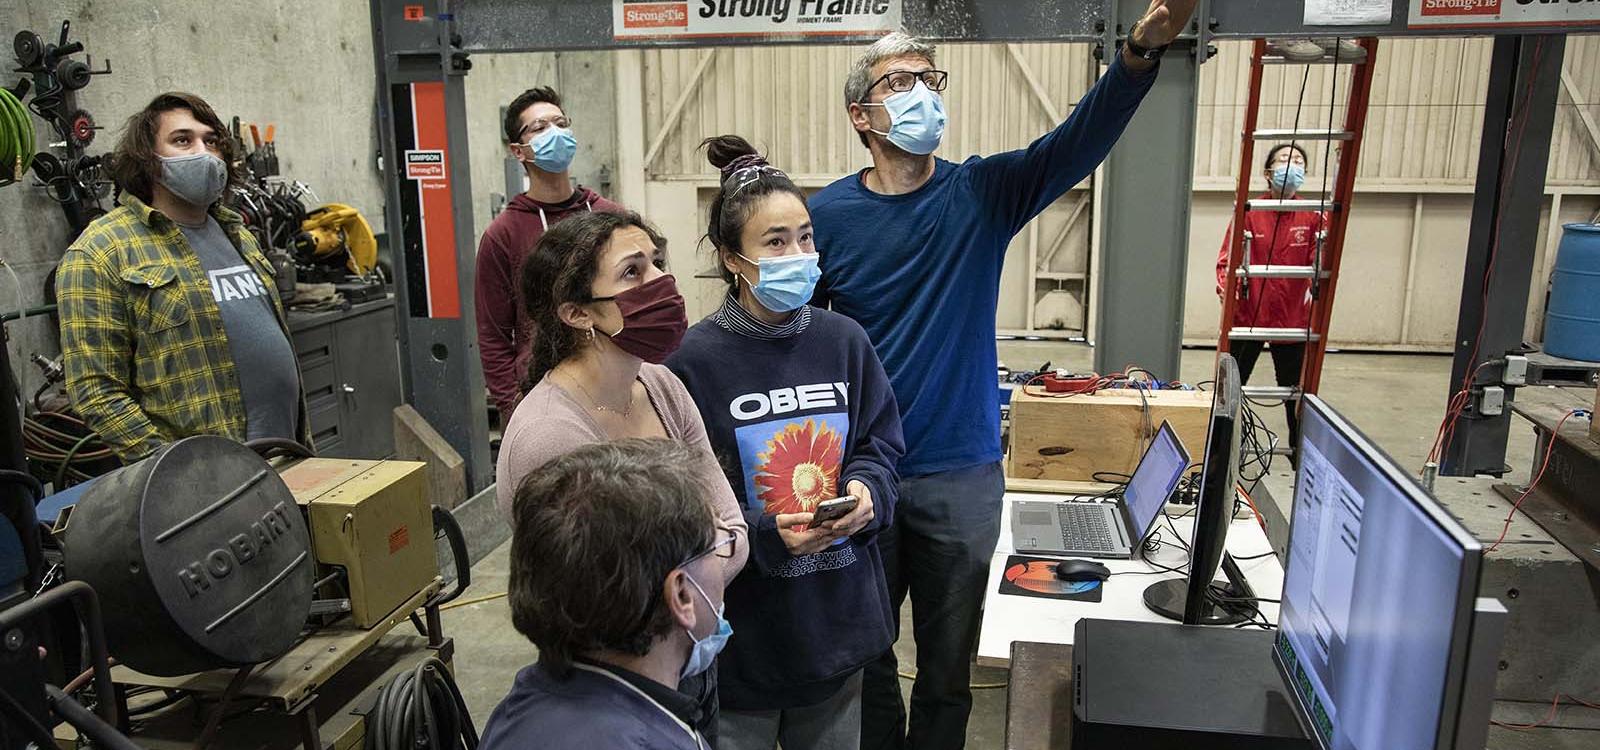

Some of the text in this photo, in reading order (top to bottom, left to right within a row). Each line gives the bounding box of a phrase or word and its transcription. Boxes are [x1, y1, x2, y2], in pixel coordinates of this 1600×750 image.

[626, 10, 685, 22] Strong-Tie
[697, 0, 889, 23] Strong Frame
[208, 264, 268, 302] VANS
[729, 382, 849, 421] OBEY
[178, 500, 292, 599] HOBART
